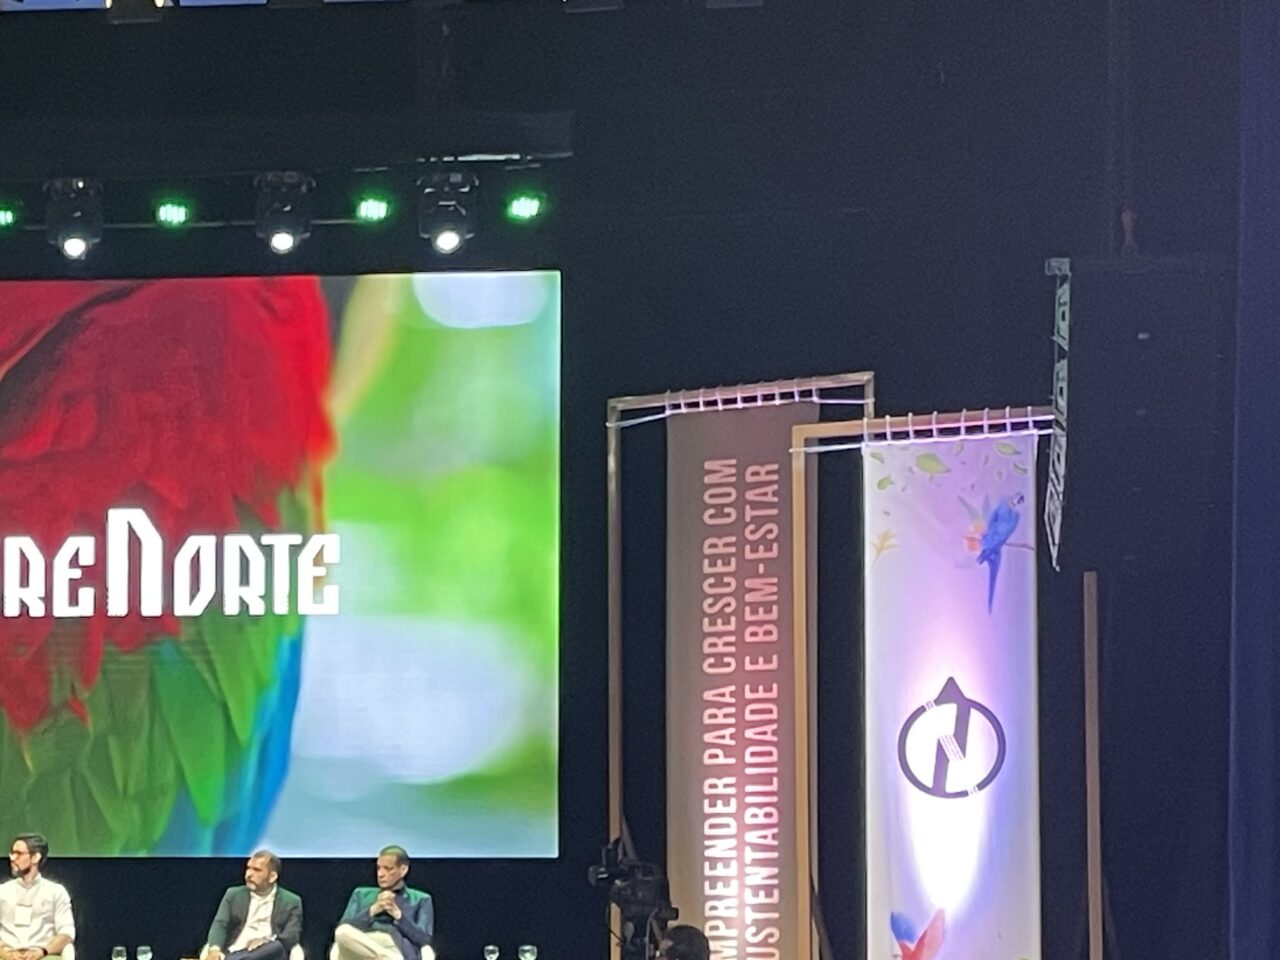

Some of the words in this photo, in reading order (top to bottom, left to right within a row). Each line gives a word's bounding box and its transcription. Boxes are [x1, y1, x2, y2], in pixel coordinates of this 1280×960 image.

[703, 458, 737, 526] COM
[744, 463, 780, 643] BEM-ESTAR
[702, 536, 737, 675] CRESCER
[744, 654, 779, 671] E
[702, 685, 737, 766] PARA
